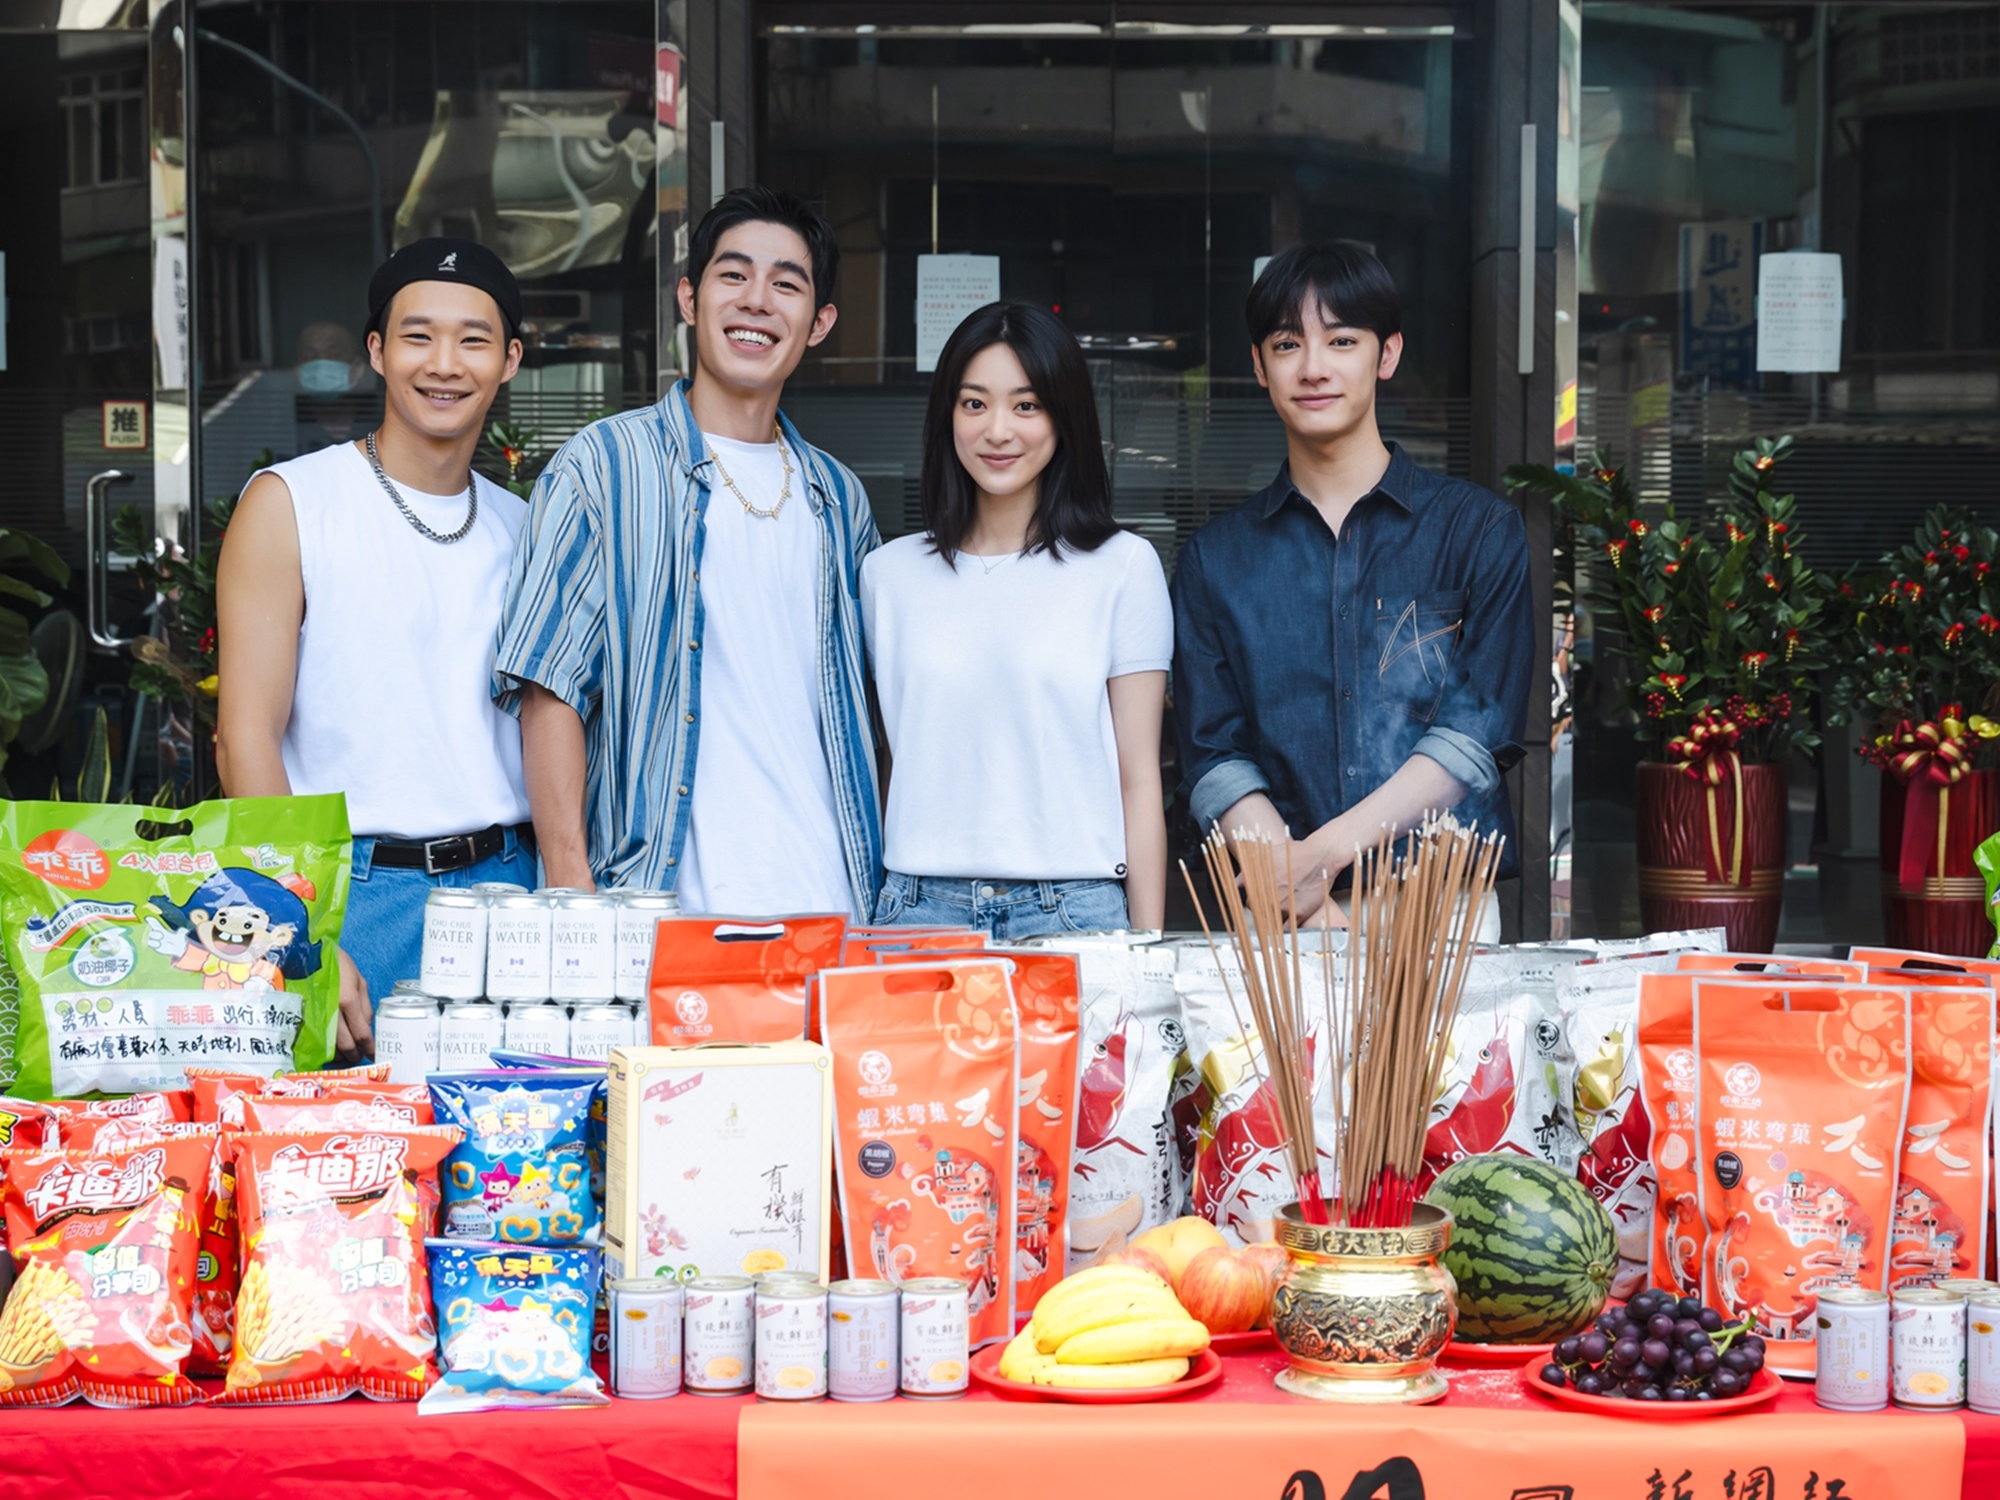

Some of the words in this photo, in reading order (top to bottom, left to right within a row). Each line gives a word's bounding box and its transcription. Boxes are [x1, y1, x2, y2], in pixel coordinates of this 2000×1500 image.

[112, 407, 138, 432] 推
[110, 435, 140, 444] PUSH
[27, 850, 105, 880] 乖乖
[429, 928, 474, 944] WATER
[495, 932, 541, 944] WATER
[555, 932, 598, 944] WATER
[620, 932, 652, 944] WATE
[78, 959, 130, 974] 奶油椰子
[166, 1005, 215, 1025] 乖乖
[376, 1042, 403, 1054] ATER
[443, 1042, 488, 1054] WATER
[507, 1043, 552, 1054] WATER
[89, 1097, 160, 1117] Cadina
[335, 1101, 412, 1125] Cadina
[326, 1136, 405, 1154] Cadina
[90, 1150, 161, 1180] Cadina
[262, 1147, 402, 1207] 卡迪那
[27, 1160, 160, 1218] 卡迪那
